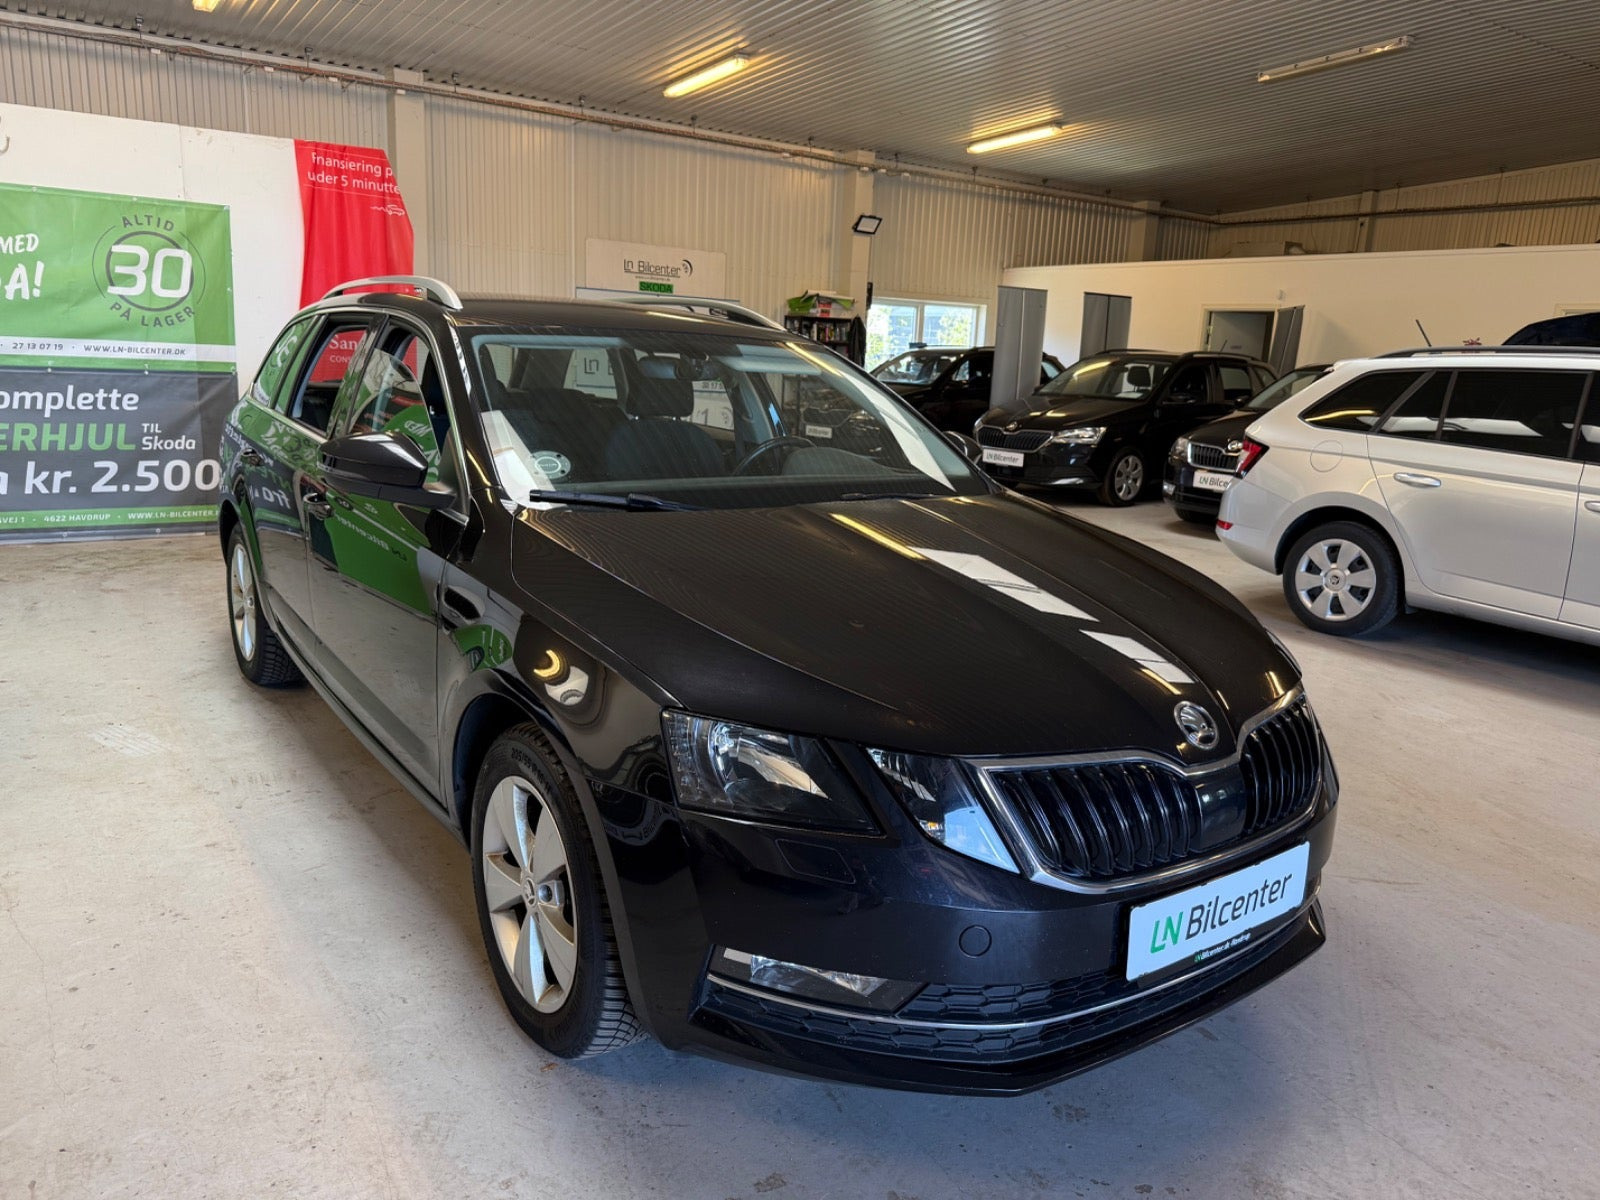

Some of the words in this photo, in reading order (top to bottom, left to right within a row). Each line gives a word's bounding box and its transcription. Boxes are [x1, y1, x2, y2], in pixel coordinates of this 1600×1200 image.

[341, 175, 349, 187] 5
[122, 214, 175, 232] ALTID
[0, 233, 40, 255] MED
[0, 260, 45, 300] A!
[106, 244, 193, 299] 30
[140, 305, 196, 328] LAGER
[12, 342, 24, 350] 27
[27, 342, 37, 351] 13
[39, 343, 51, 351] 07
[54, 343, 64, 351] 19
[141, 423, 162, 434] TIL
[141, 435, 196, 450] Skoda
[24, 460, 78, 495] kr.
[91, 458, 221, 494] 2.500
[0, 516, 18, 524] VEJ
[69, 513, 111, 521] HAVDRUP
[1150, 911, 1184, 954] LN
[1185, 873, 1293, 941] Bilcenter
